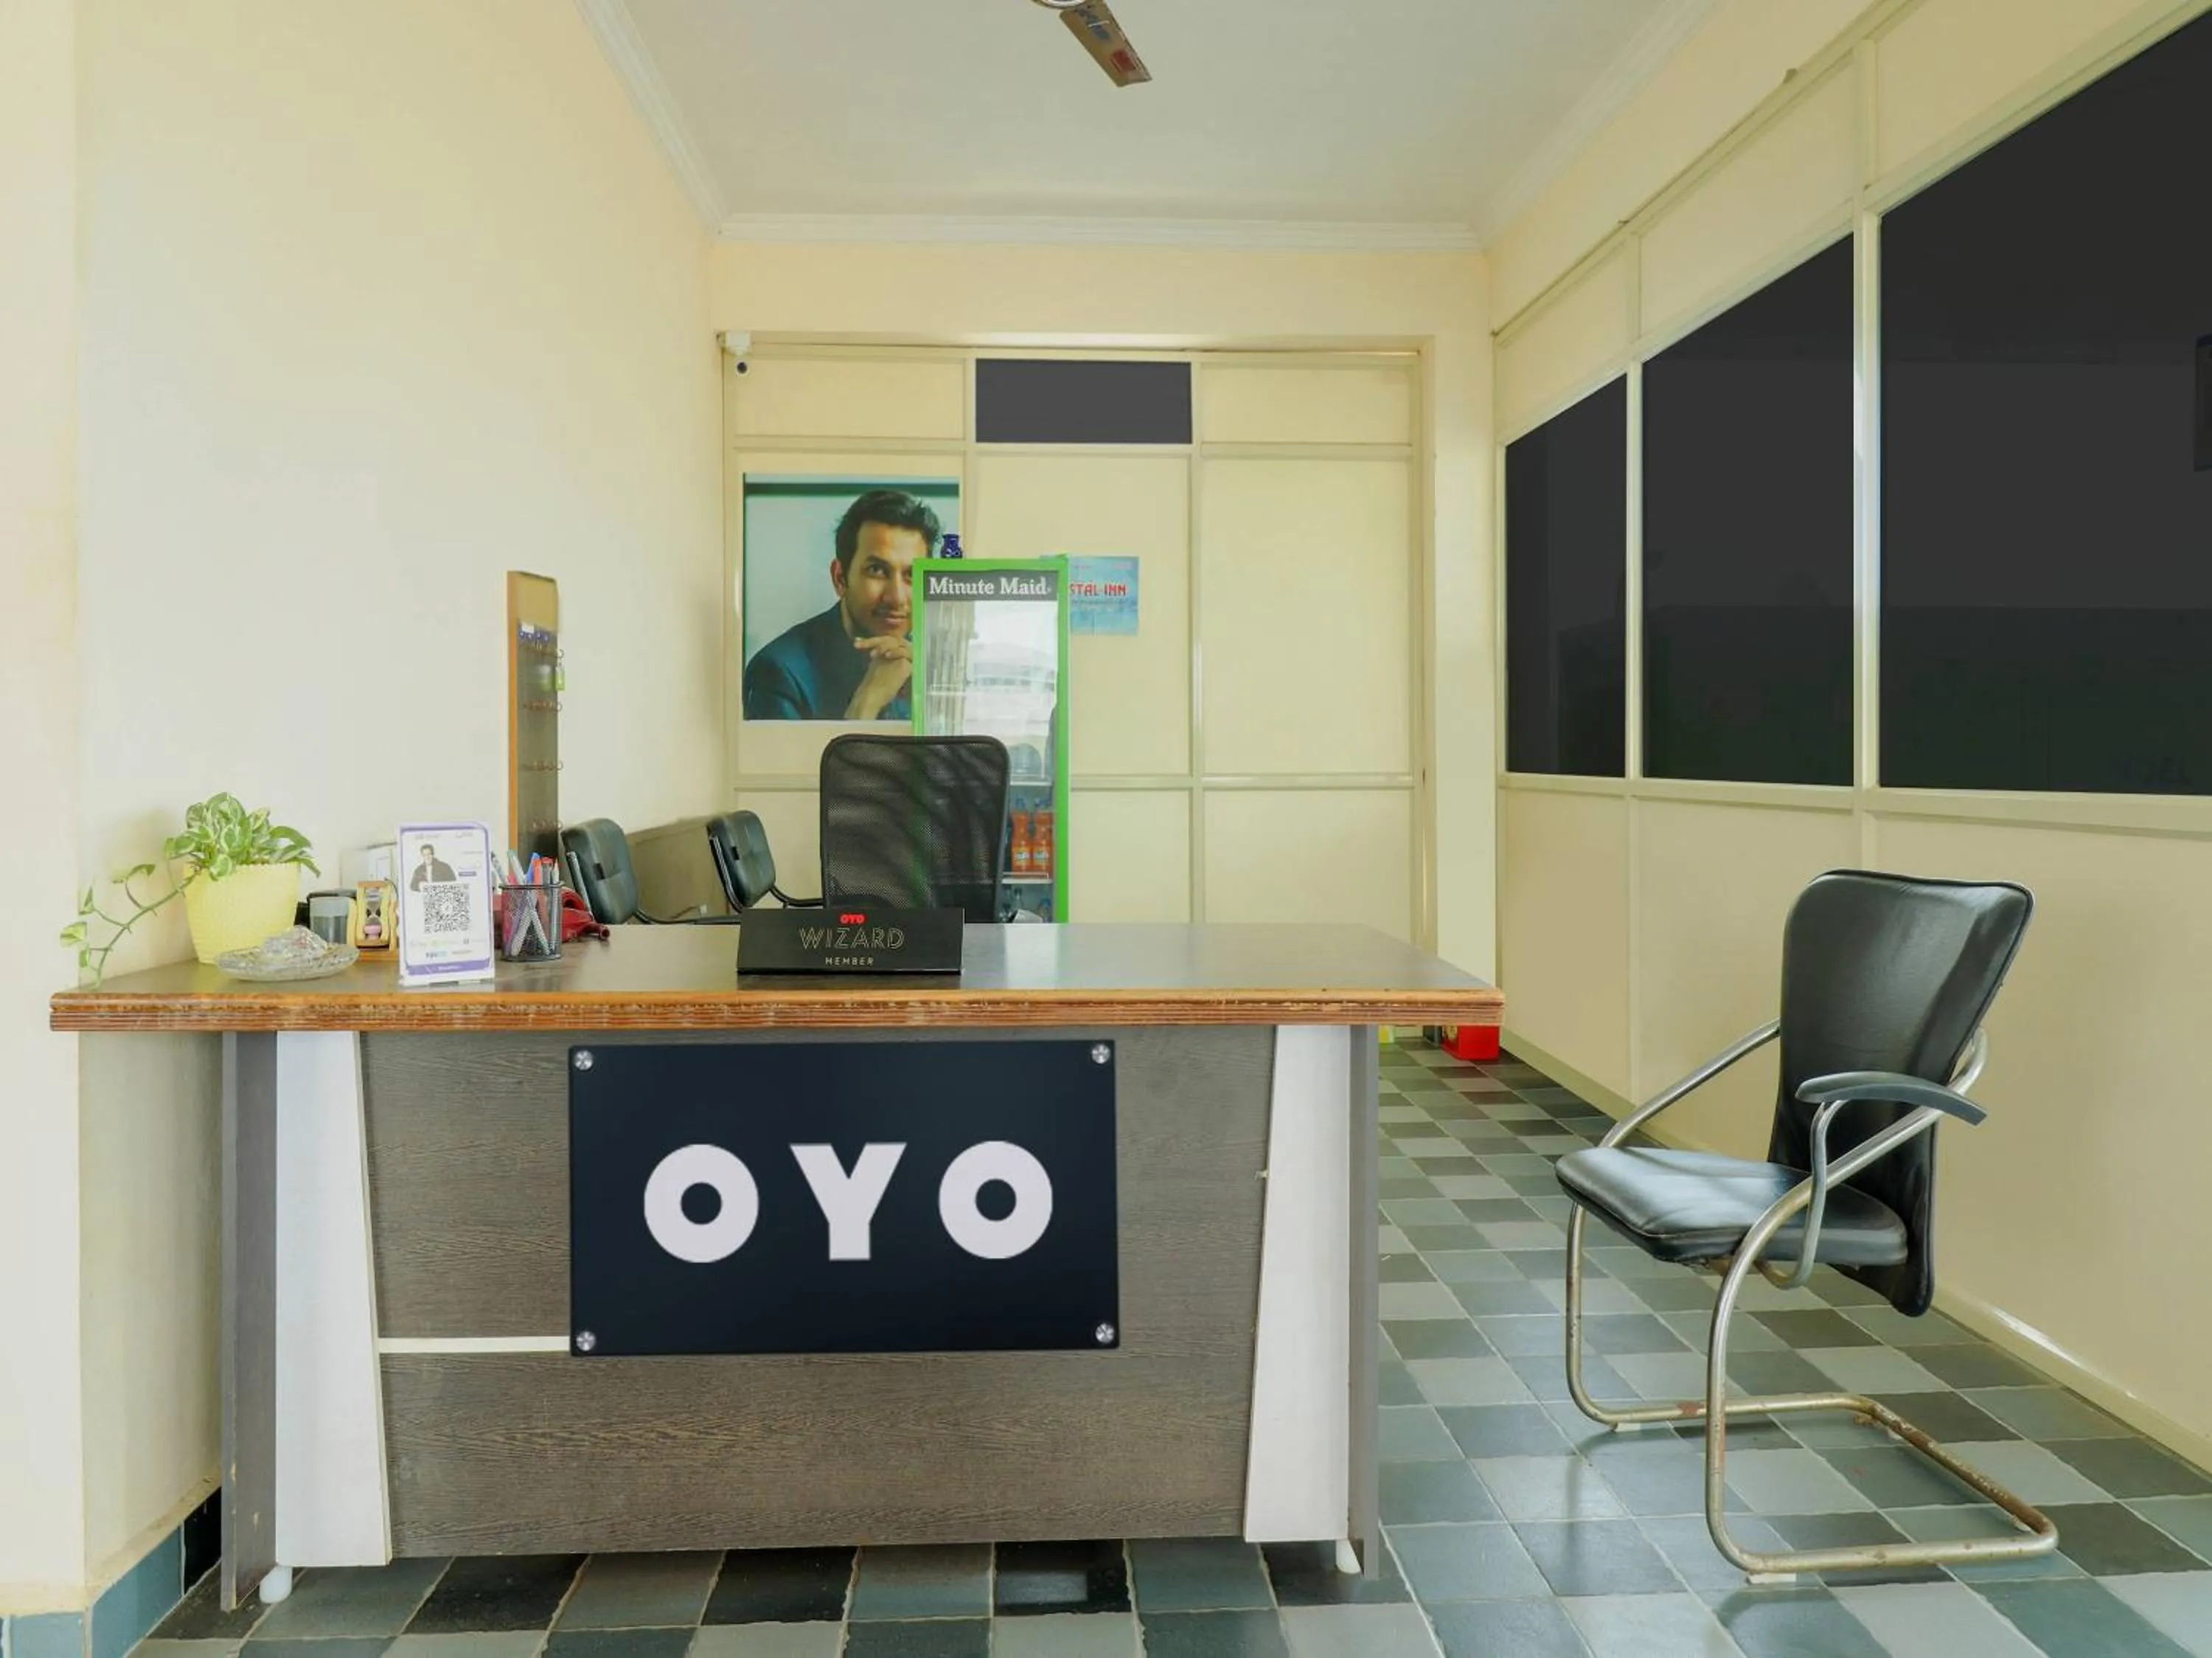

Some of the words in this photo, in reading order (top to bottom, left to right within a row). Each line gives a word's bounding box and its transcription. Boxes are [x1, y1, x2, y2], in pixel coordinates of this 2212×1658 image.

[928, 576, 995, 595] Minute
[999, 576, 1047, 595] Maid
[839, 913, 866, 924] OYO
[799, 927, 905, 950] WIZARD
[824, 957, 874, 966] MEMBER
[644, 1140, 1054, 1263] OYO
